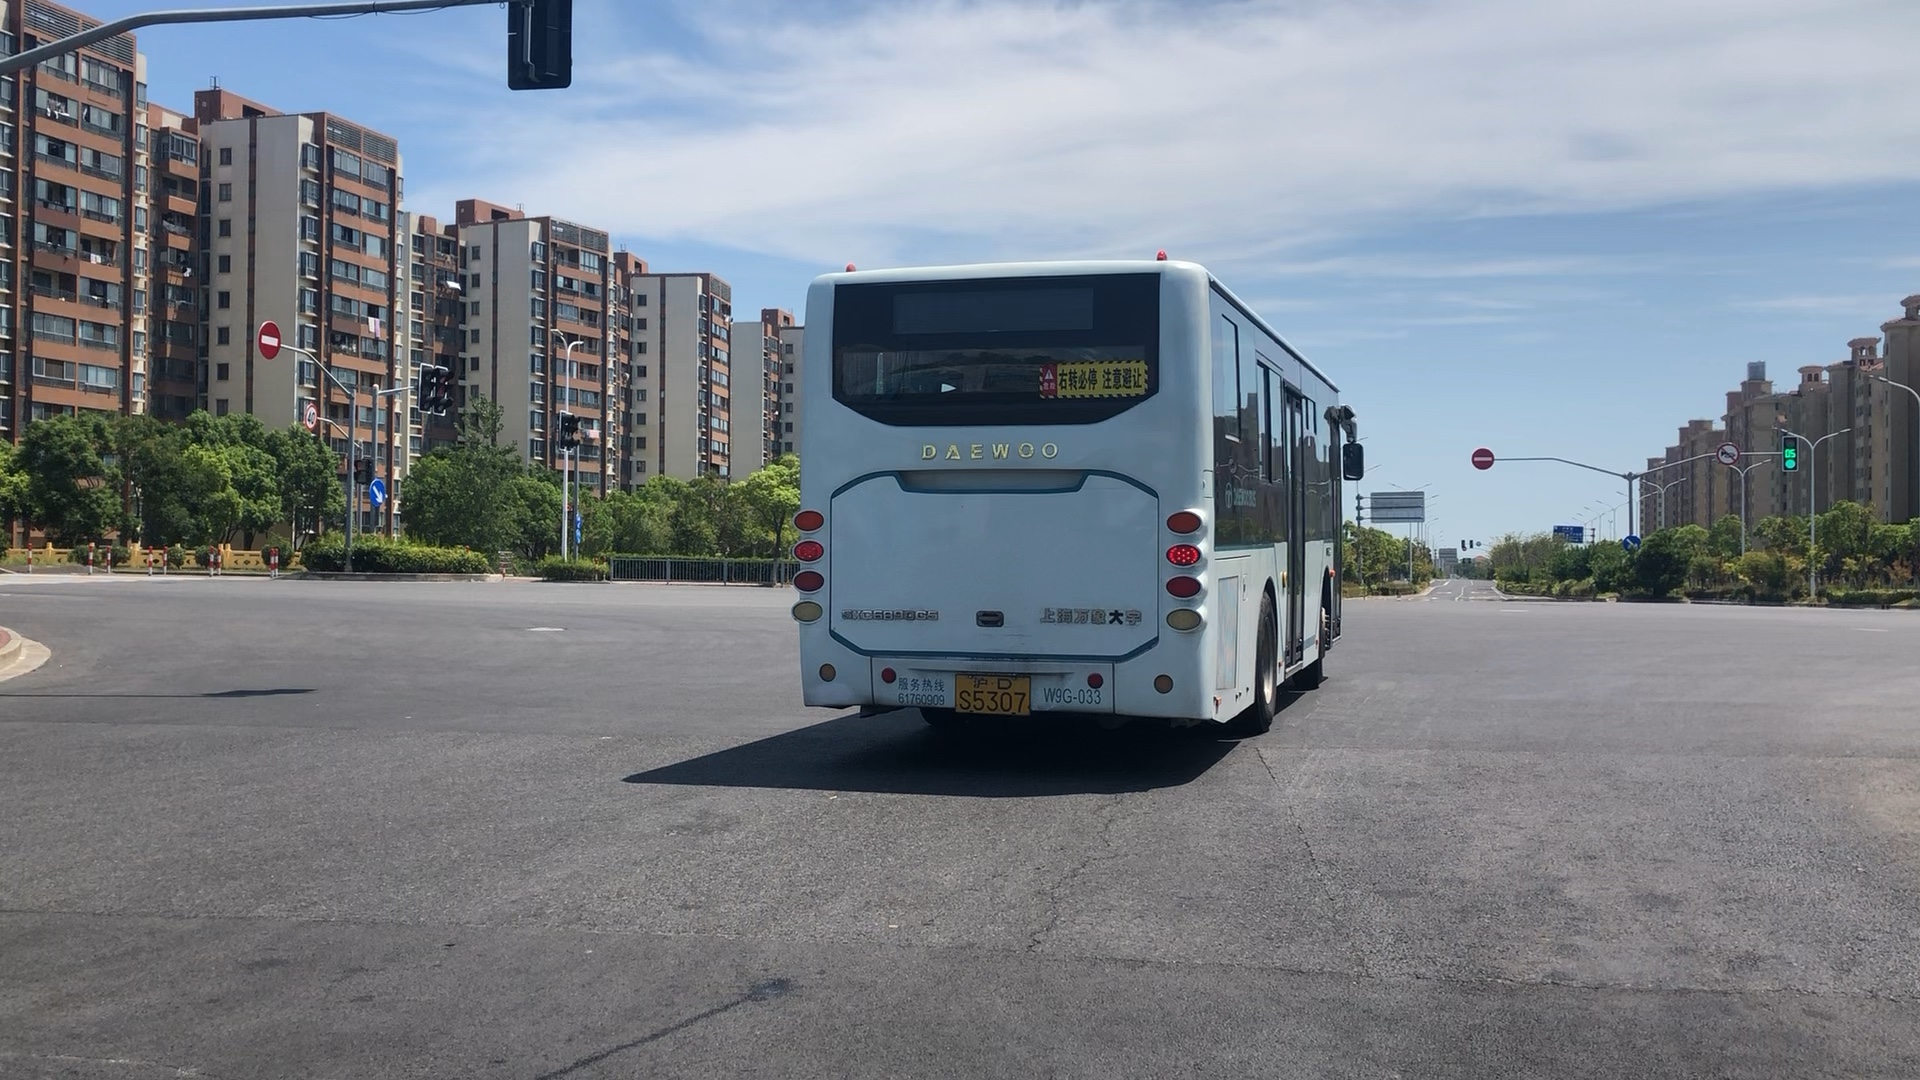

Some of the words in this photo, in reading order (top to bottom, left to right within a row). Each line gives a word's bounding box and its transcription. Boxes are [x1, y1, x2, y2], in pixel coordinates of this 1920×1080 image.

[1058, 367, 1098, 391] 右转必停
[1102, 367, 1142, 390] 注意避让
[921, 442, 1059, 460] DAEWOO
[1784, 448, 1796, 459] 05
[1040, 607, 1142, 626] 上海万象大宇
[898, 677, 945, 692] 服务热线
[898, 693, 945, 706] 61760909
[959, 690, 1027, 713] S5307
[1043, 687, 1102, 705] W9G-033
